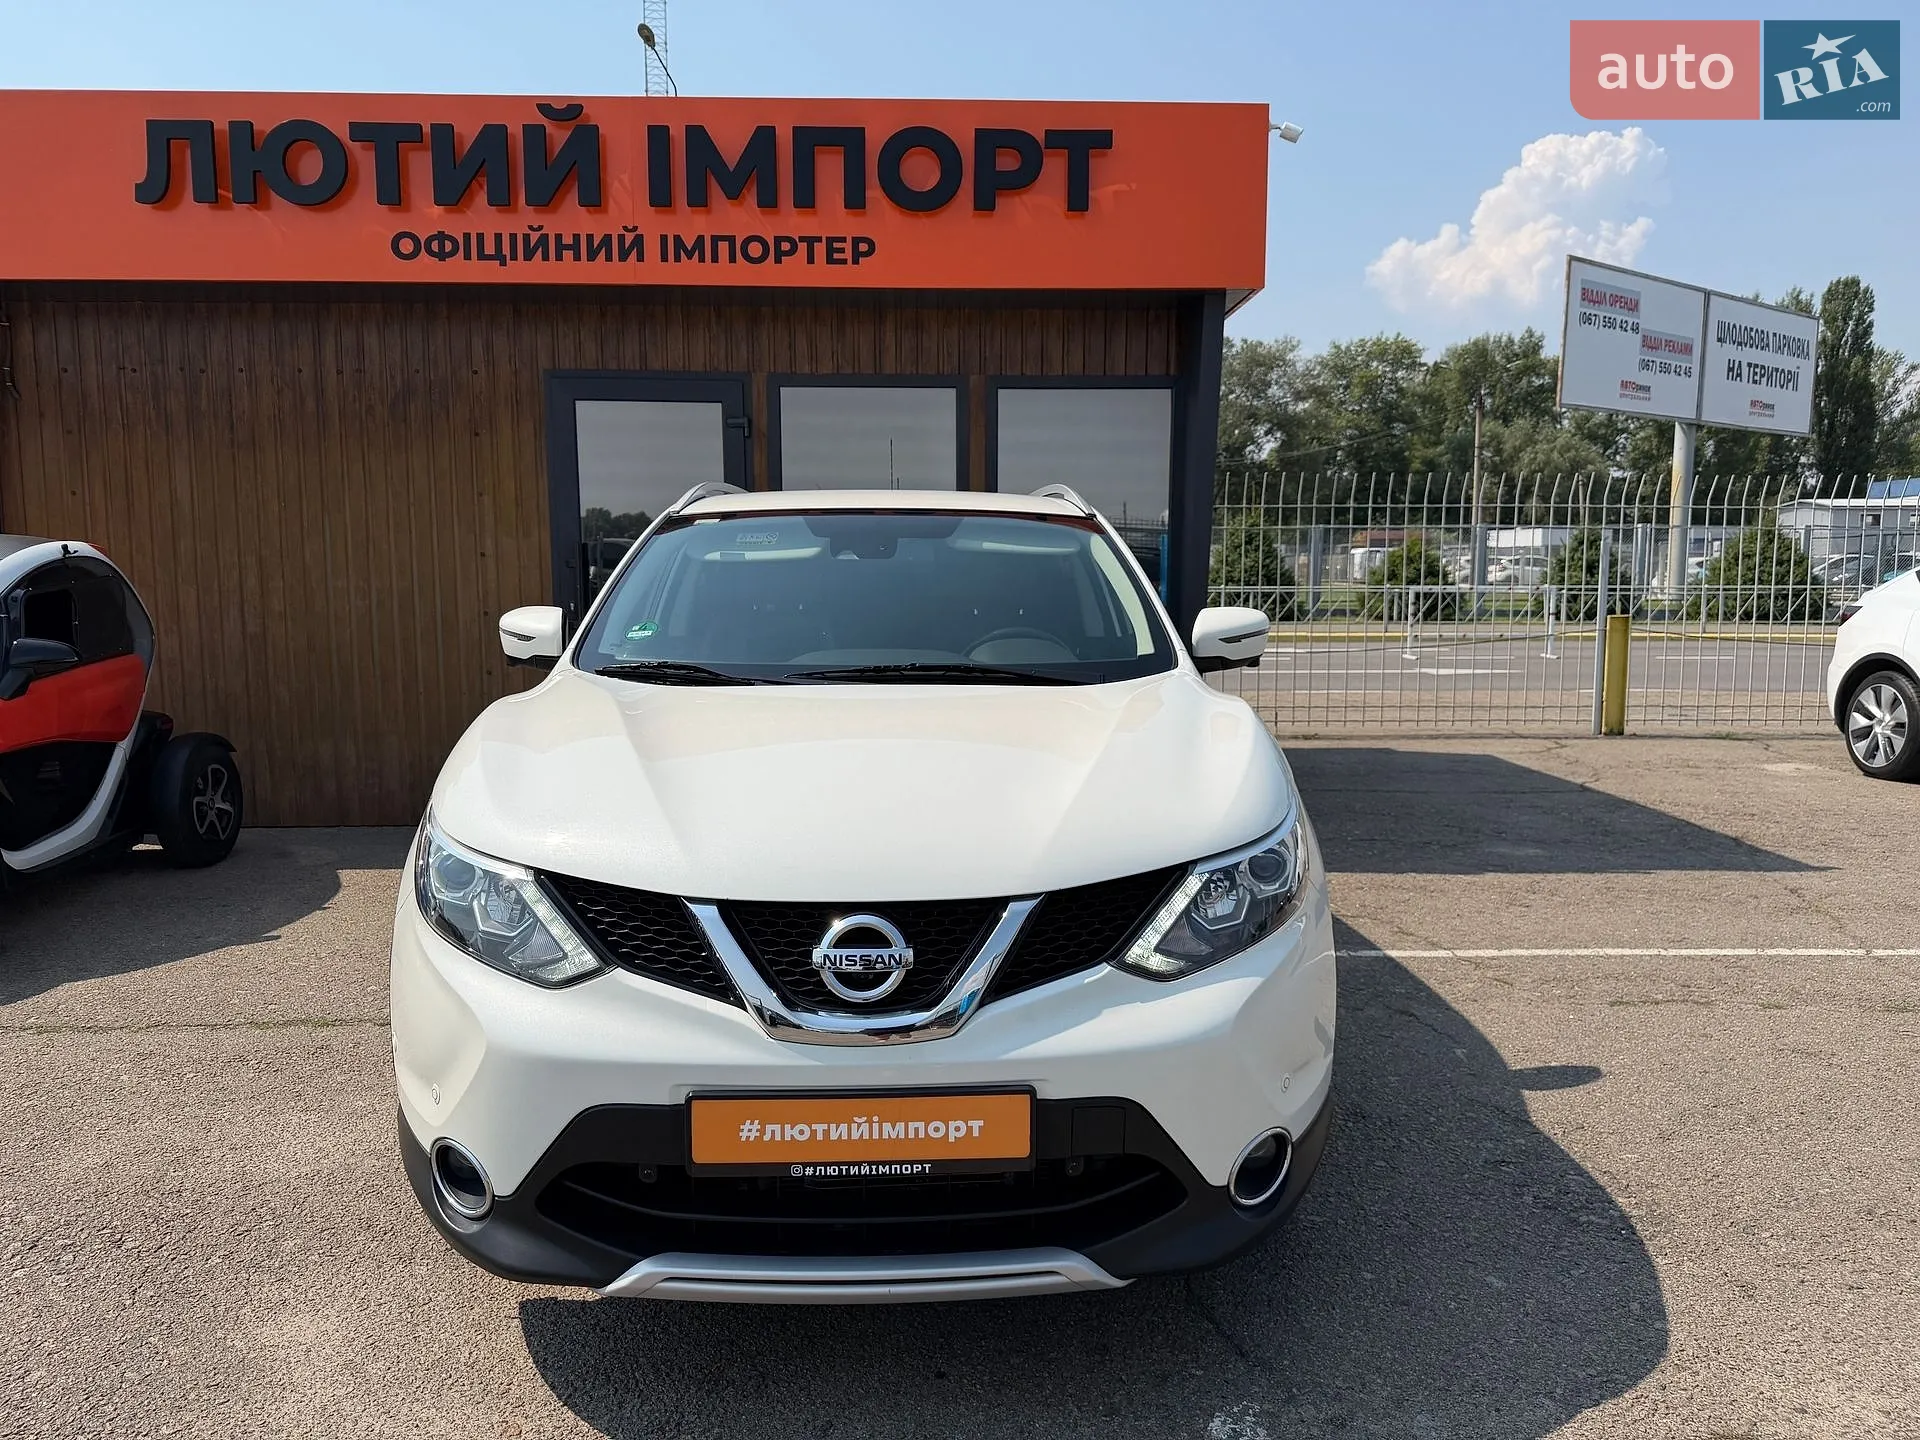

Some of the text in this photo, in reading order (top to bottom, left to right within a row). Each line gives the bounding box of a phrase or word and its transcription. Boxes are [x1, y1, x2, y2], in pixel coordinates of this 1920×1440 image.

[134, 102, 1113, 213] ЛЮТИЙ ІМПОРТ
[390, 224, 877, 267] ОФІЦІЙНИЙ ІМПОРТЕР
[1581, 287, 1639, 312] ВІДДІЛ ОРЕНДИ
[1579, 312, 1640, 335] (067) 550 42 48
[1642, 334, 1692, 356] ВІДДІЛ РЕКЛАМИ
[1716, 319, 1810, 360] ЦІЛОДОБОВА ПАРКОВКА
[1638, 357, 1692, 378] (067) 550 42 45
[1726, 358, 1800, 392] НА ТЕРИТОРІЇ
[822, 953, 903, 966] NISSAN
[739, 1116, 984, 1142] #лютийімпорт
[805, 1164, 932, 1176] #ЛЮТИЙІМПОРТ
